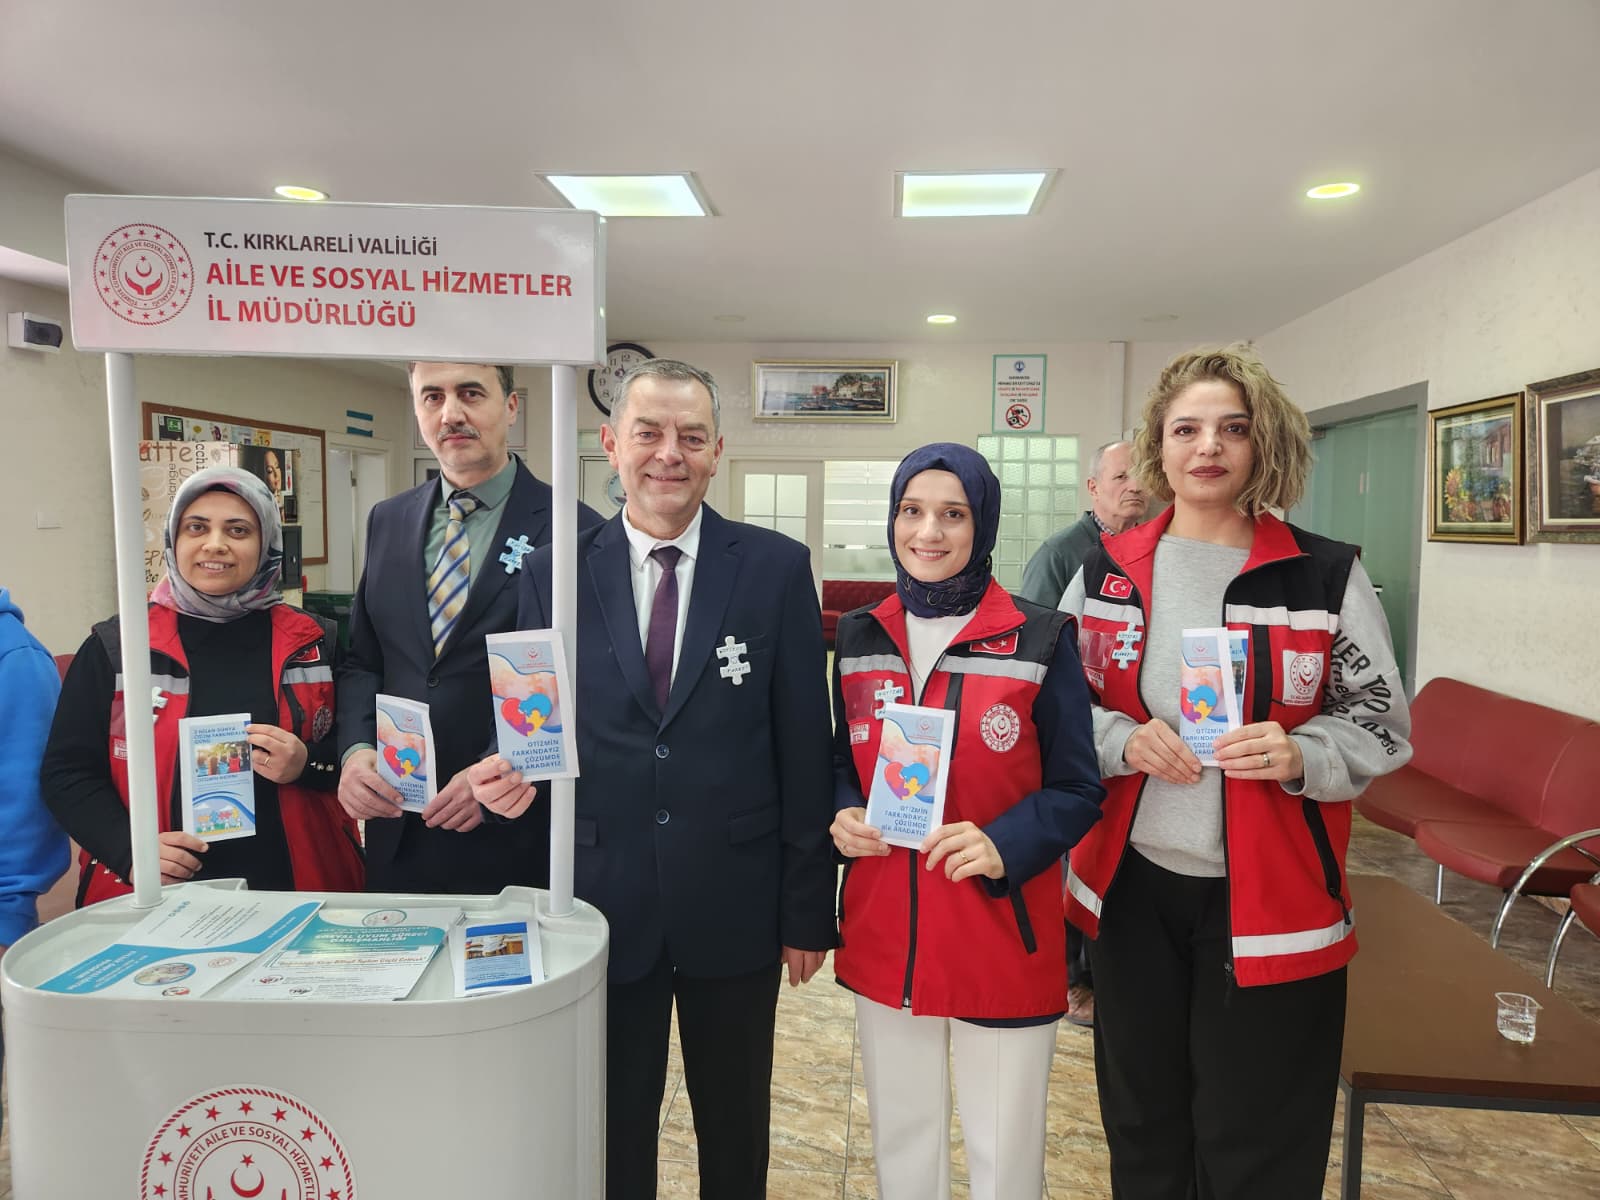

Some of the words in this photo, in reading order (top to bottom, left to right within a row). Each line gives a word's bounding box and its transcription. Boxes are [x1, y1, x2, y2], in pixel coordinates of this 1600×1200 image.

[204, 232, 239, 250] T.C.
[243, 233, 354, 254] KIRKLARELİ
[357, 235, 438, 257] VALİLİĞİ
[206, 258, 264, 287] AİLE
[270, 265, 304, 288] VE
[311, 266, 415, 292] SOSYAL
[422, 266, 573, 297] HİZMETLER
[207, 294, 231, 322] İL
[238, 296, 417, 328] MÜDÜRLÜĞÜ
[138, 441, 193, 463] atte
[167, 463, 179, 504] elange
[511, 746, 560, 757] FARKINDAYIZ
[527, 739, 559, 748] OTİZMİN
[524, 753, 561, 764] ÇÖZÜMDE
[900, 804, 928, 815] OTİZMİN
[205, 1126, 229, 1148] AİLE
[229, 1126, 246, 1138] VE
[248, 1127, 290, 1152] SOSYAL
[289, 1148, 316, 1200] HİZMETL
